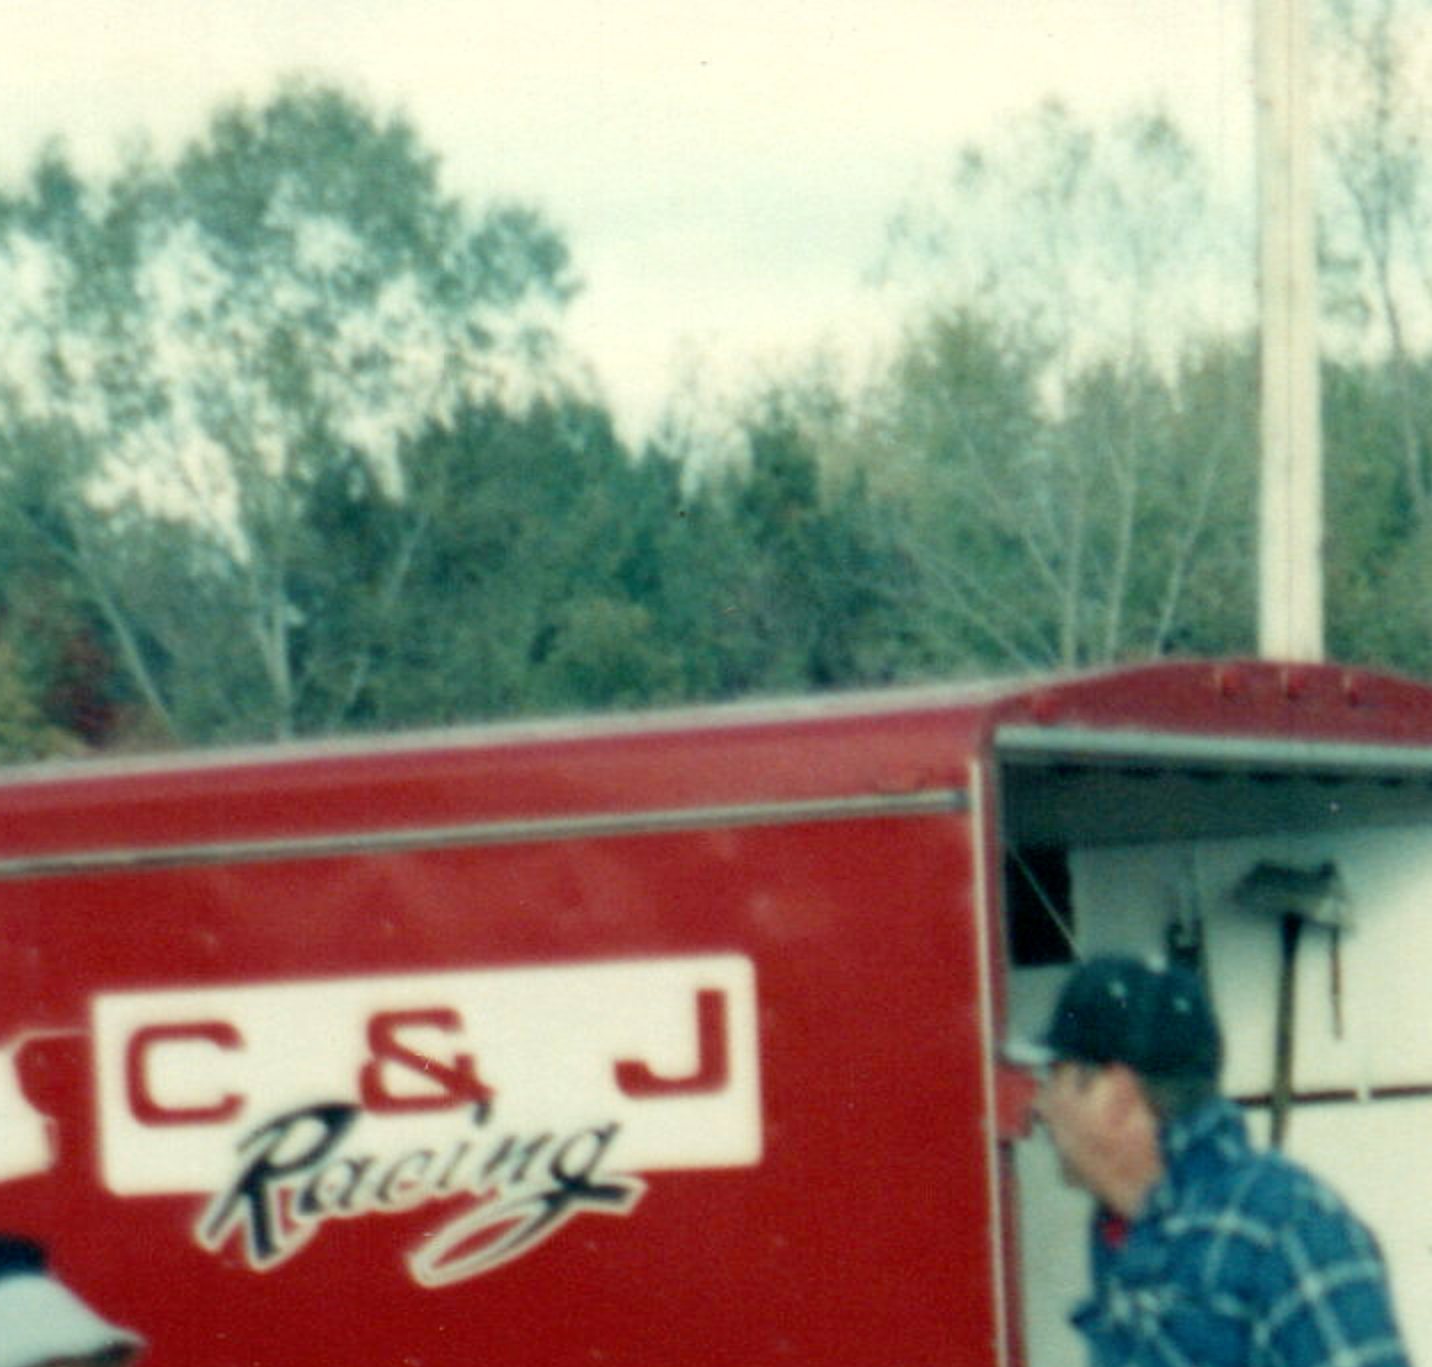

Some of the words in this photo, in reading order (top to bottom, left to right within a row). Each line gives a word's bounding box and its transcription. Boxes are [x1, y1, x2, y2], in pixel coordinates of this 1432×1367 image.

[124, 1019, 246, 1128] C
[361, 1008, 496, 1114] &
[615, 990, 729, 1100] J
[196, 1098, 646, 1288] Racing
